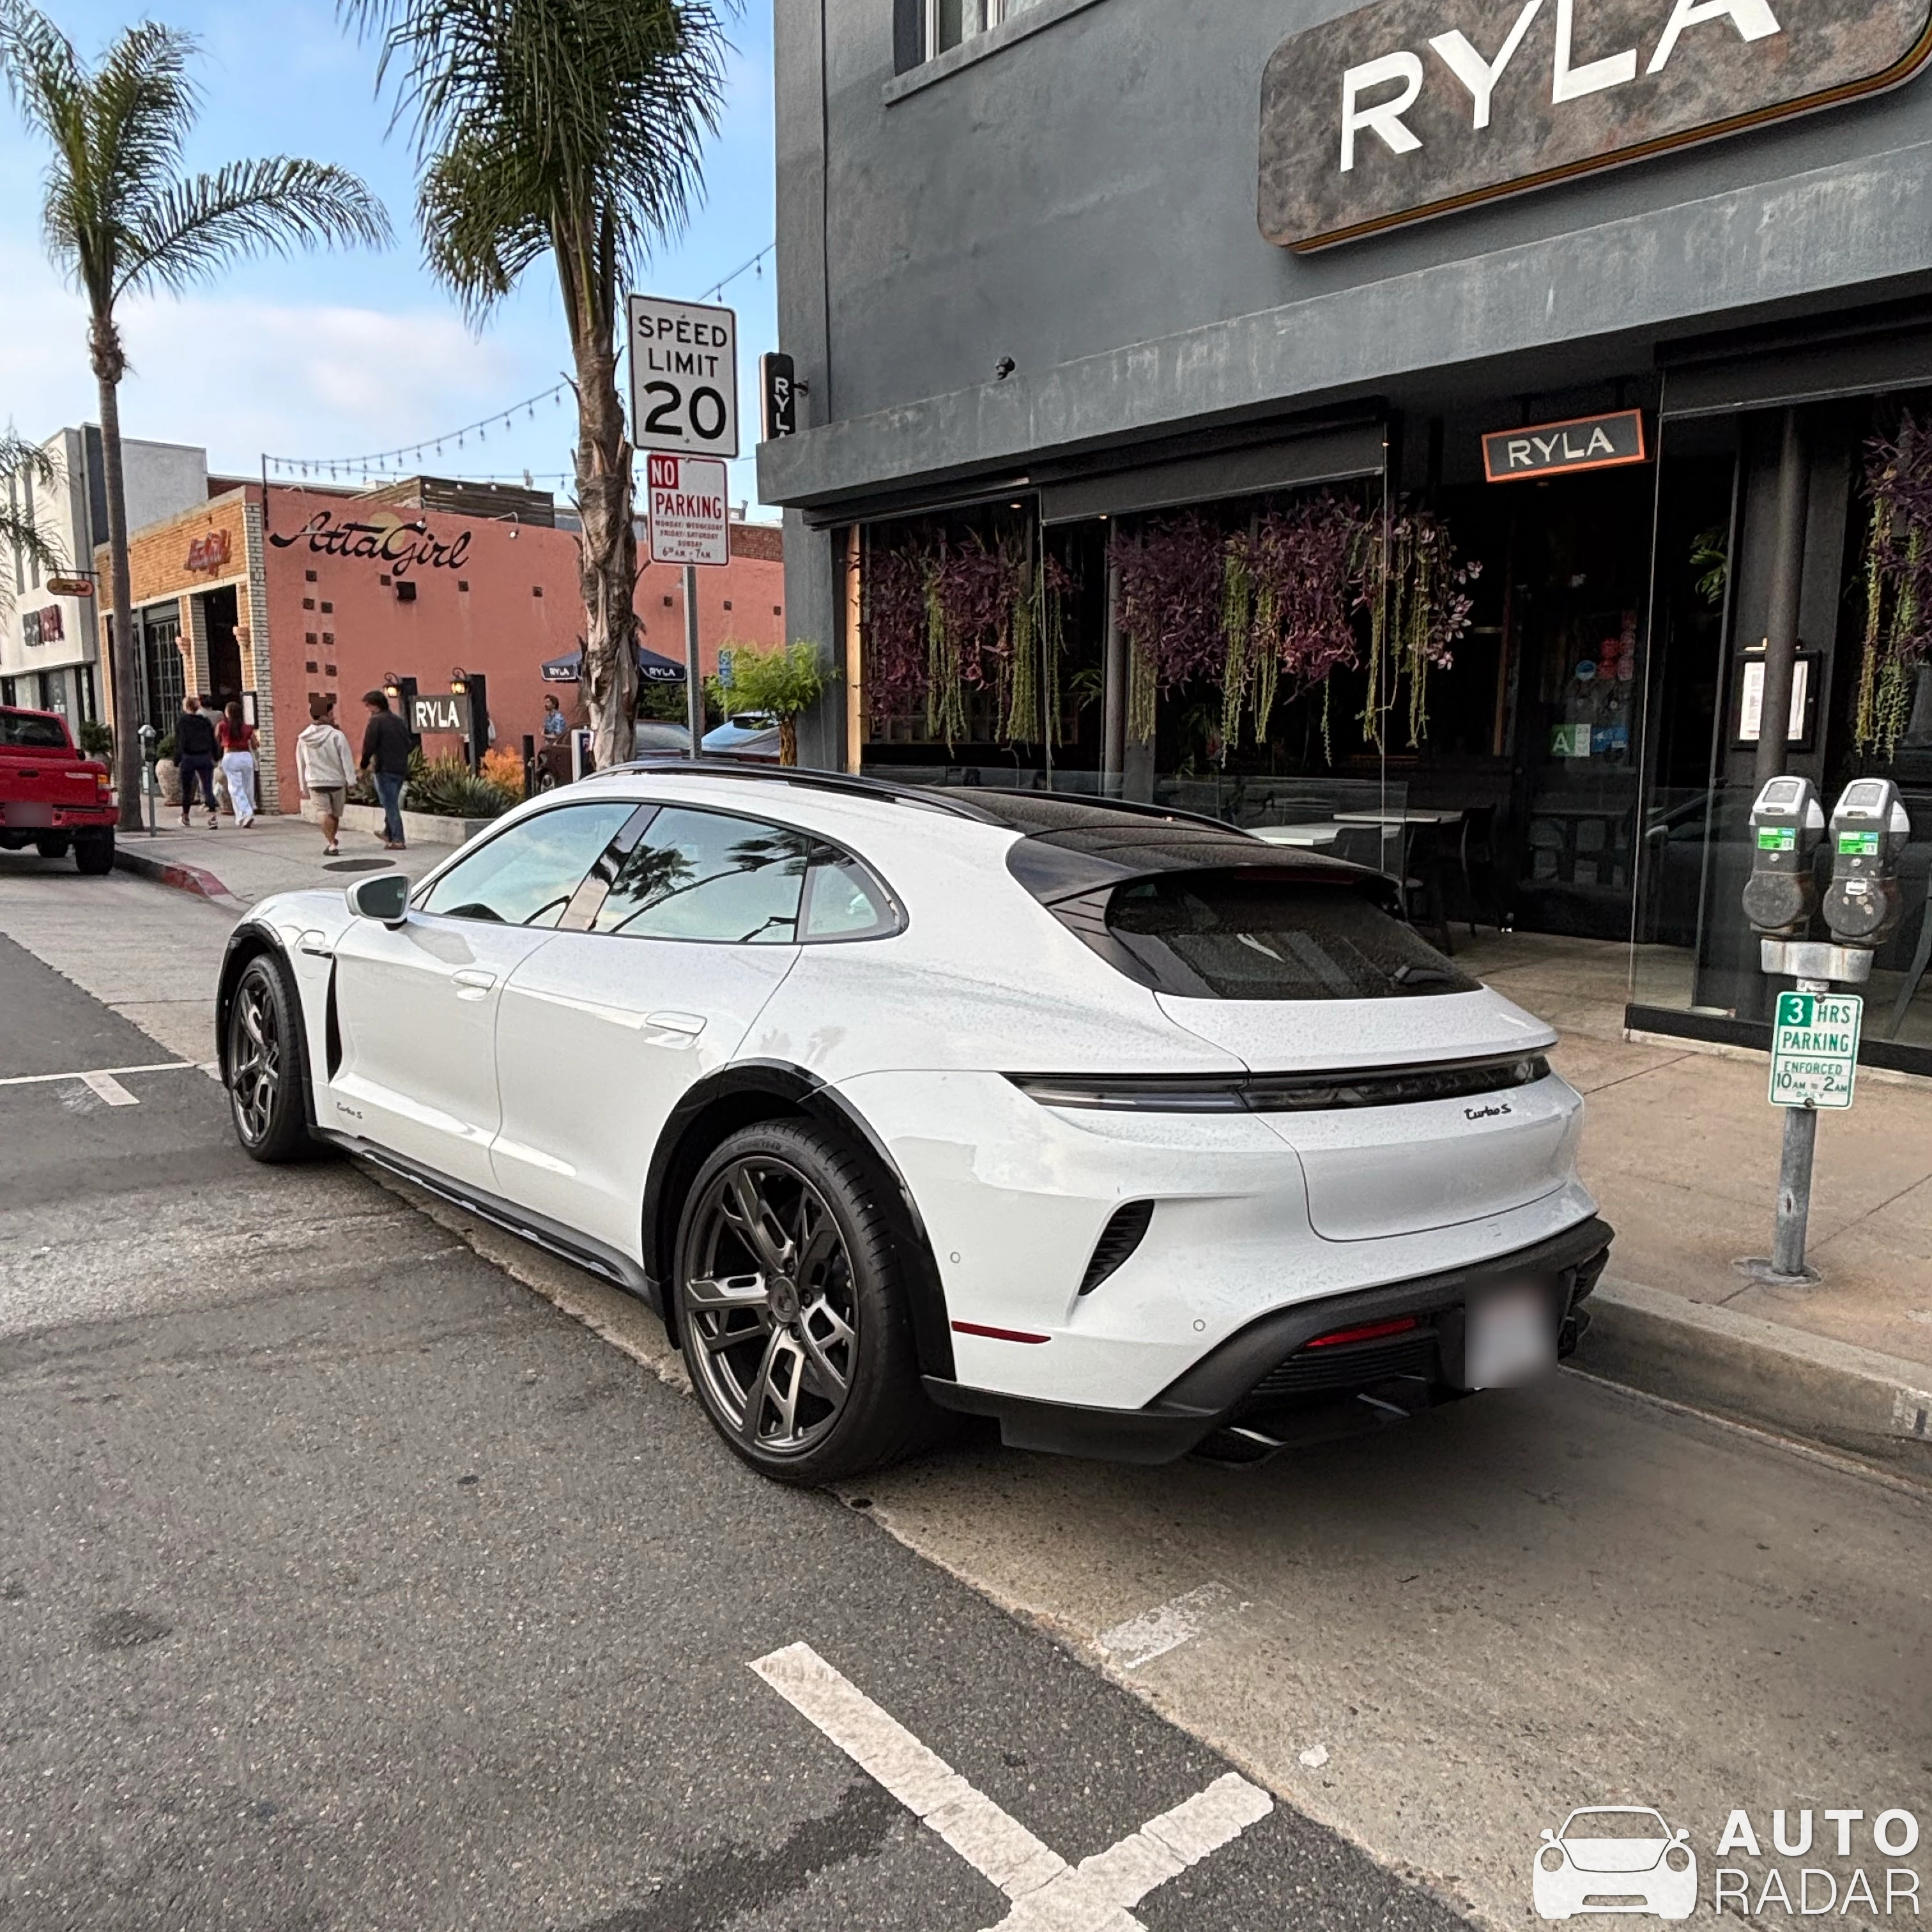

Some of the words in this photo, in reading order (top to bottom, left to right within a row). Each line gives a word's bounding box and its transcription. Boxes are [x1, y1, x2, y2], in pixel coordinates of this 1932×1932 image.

[638, 315, 727, 347] SPEED
[648, 348, 719, 378] LIMIT
[643, 381, 726, 440] 20
[1508, 427, 1614, 467] RYLA
[651, 459, 675, 486] NO
[656, 493, 722, 519] PARKING
[549, 667, 570, 676] RYLA
[649, 667, 676, 677] RYLA
[415, 701, 460, 728] RYLA
[1551, 732, 1570, 753] A
[1787, 998, 1804, 1023] 3
[1817, 1004, 1850, 1023] HRS
[1782, 1031, 1850, 1052] PARKING
[1784, 1061, 1843, 1076] ENFORCED
